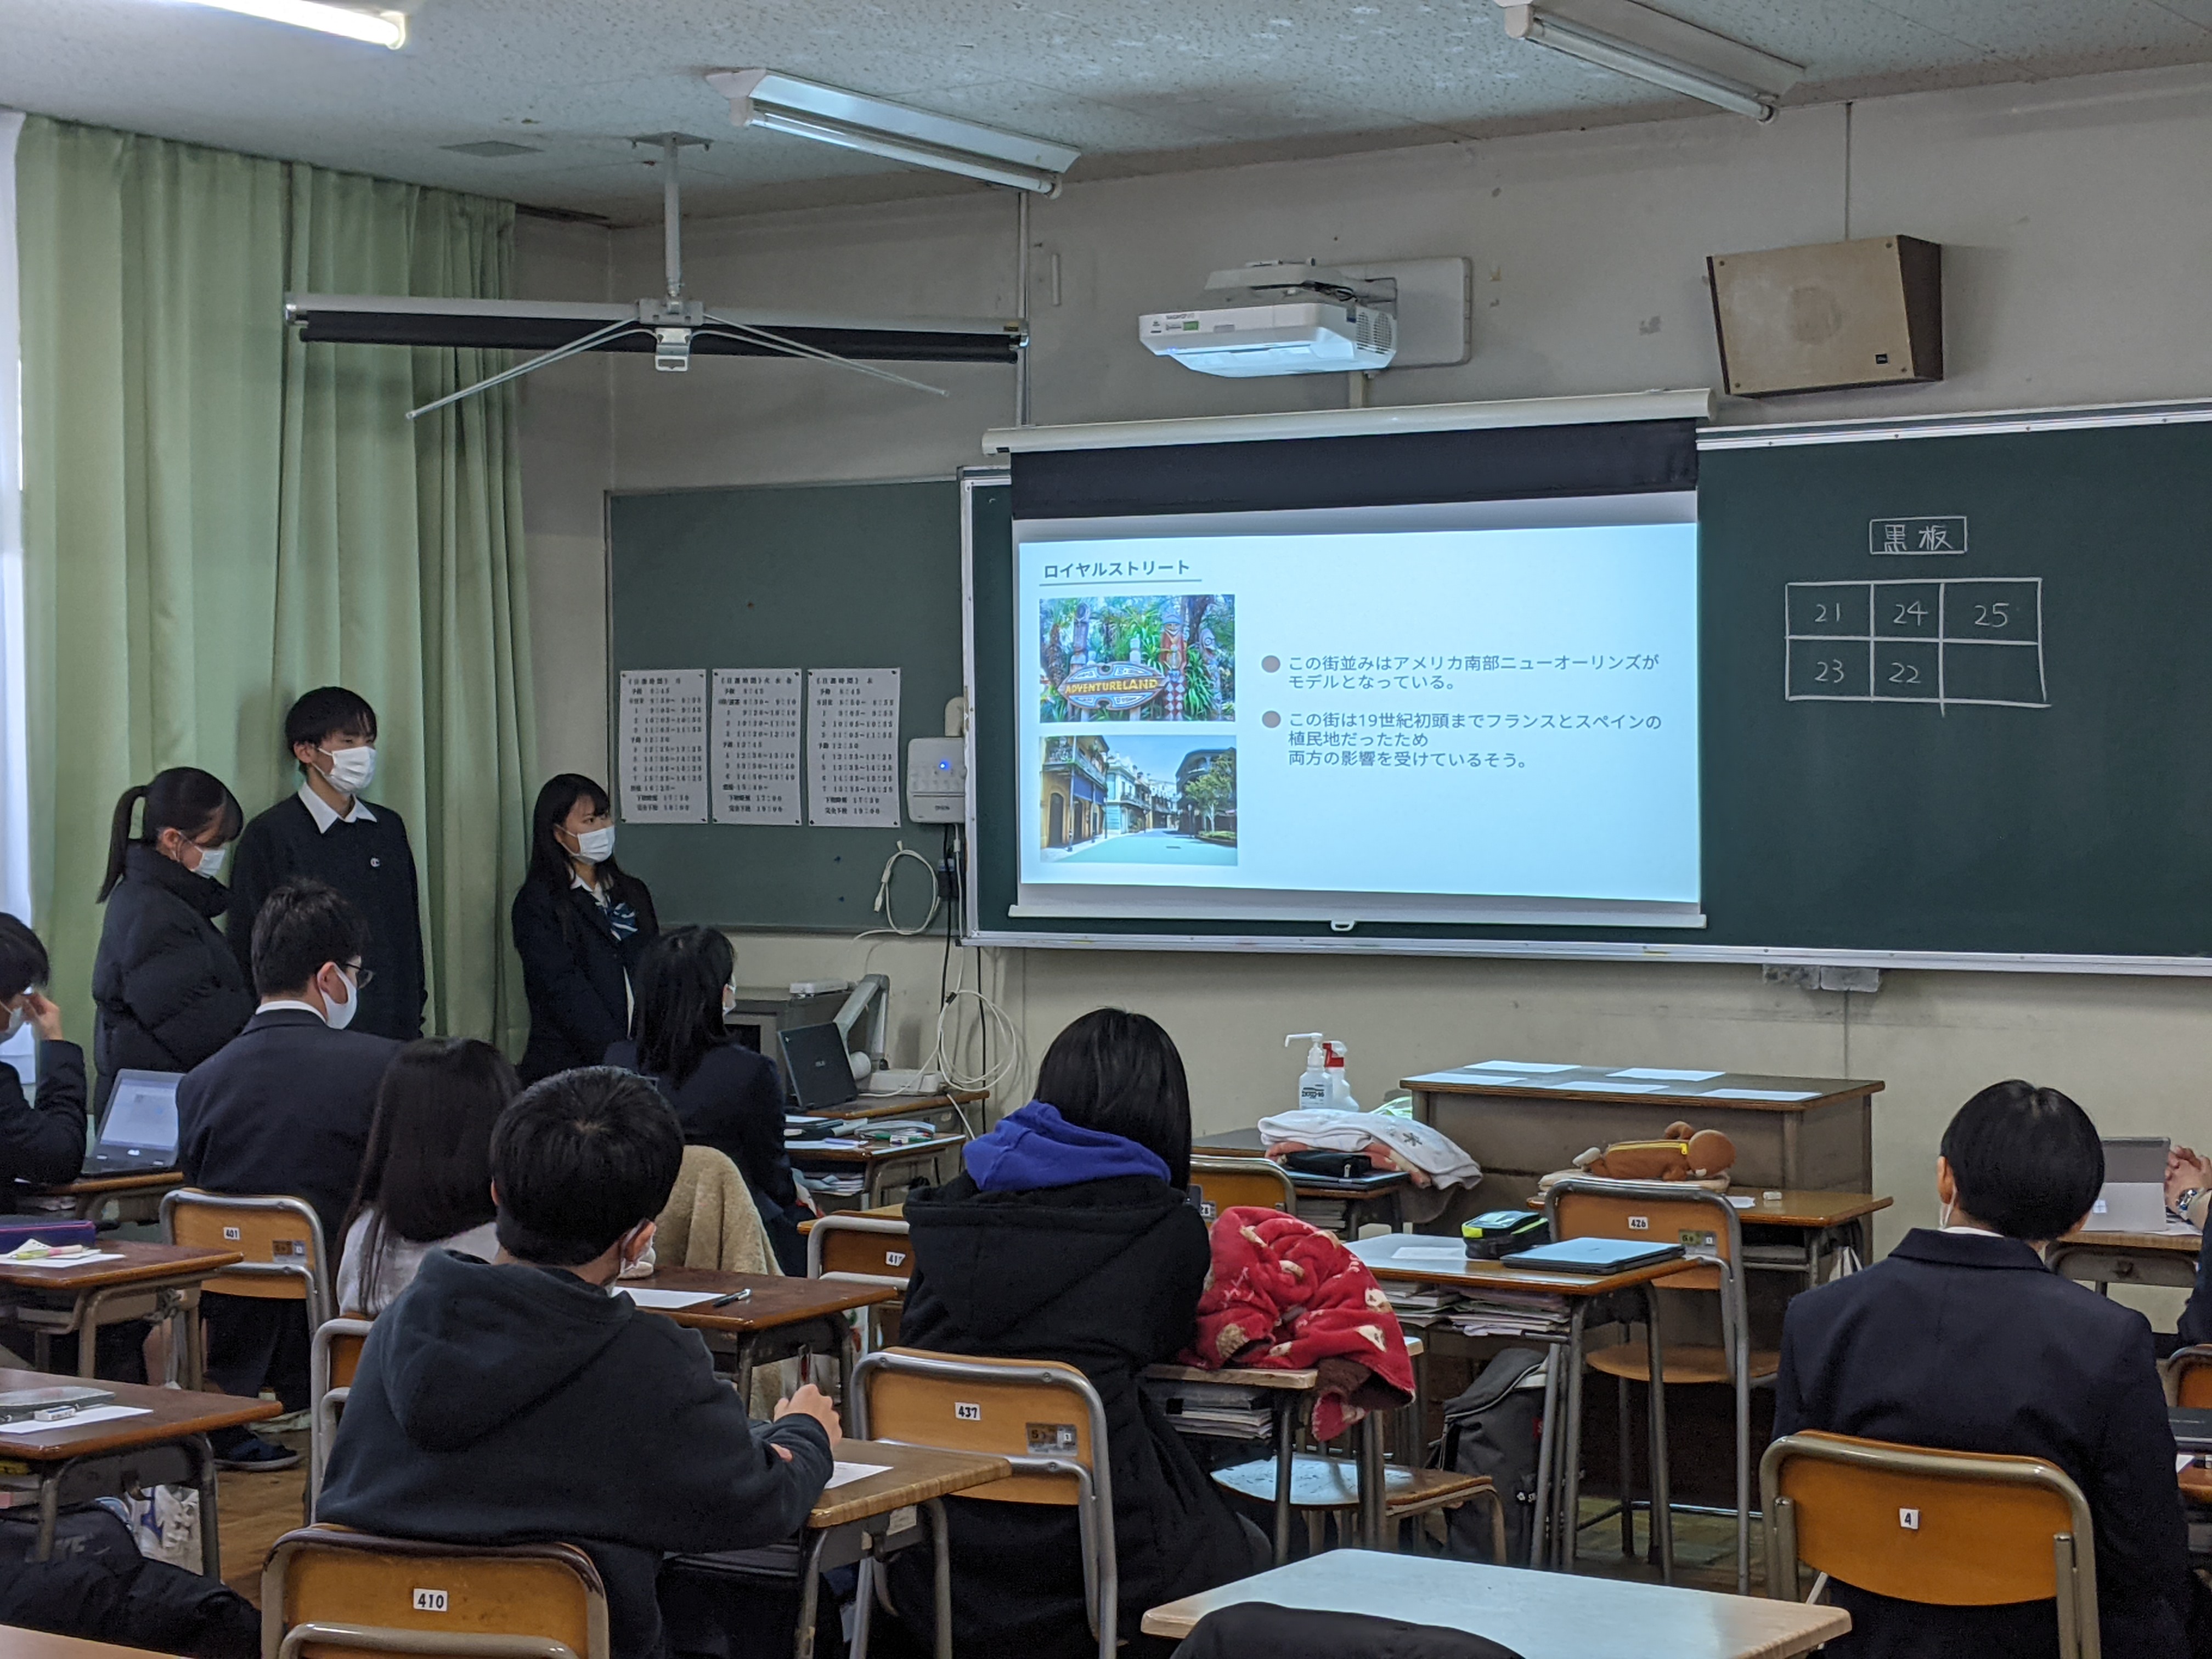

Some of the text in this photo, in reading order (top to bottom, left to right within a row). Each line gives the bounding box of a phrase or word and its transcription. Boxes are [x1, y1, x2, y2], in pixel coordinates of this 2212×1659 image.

[1883, 523, 1954, 552] 黒板
[1045, 560, 1189, 578] ロイヤルストリート
[1814, 603, 1841, 623] 21
[1893, 601, 1928, 626] 24
[1974, 603, 2010, 628] 25
[1289, 654, 1660, 671] この街並みはアメリカ南部ニューオーリンズが
[1814, 659, 1845, 682] 23
[1888, 662, 1921, 684] 22
[1065, 679, 1158, 694] ADVENTURELAND
[1289, 674, 1454, 690] モデルとなっている。
[1290, 713, 1662, 729] この街は19世紀初頭までフランスとスペインの
[1288, 731, 1428, 747] 植民地だったため
[1289, 750, 1526, 767] 両方の影響を受けているそう。
[1631, 1219, 1646, 1228] 426
[226, 1229, 238, 1238] 401
[958, 1406, 978, 1418] 437
[1905, 1512, 1911, 1526] 4
[417, 1593, 444, 1609] 410
